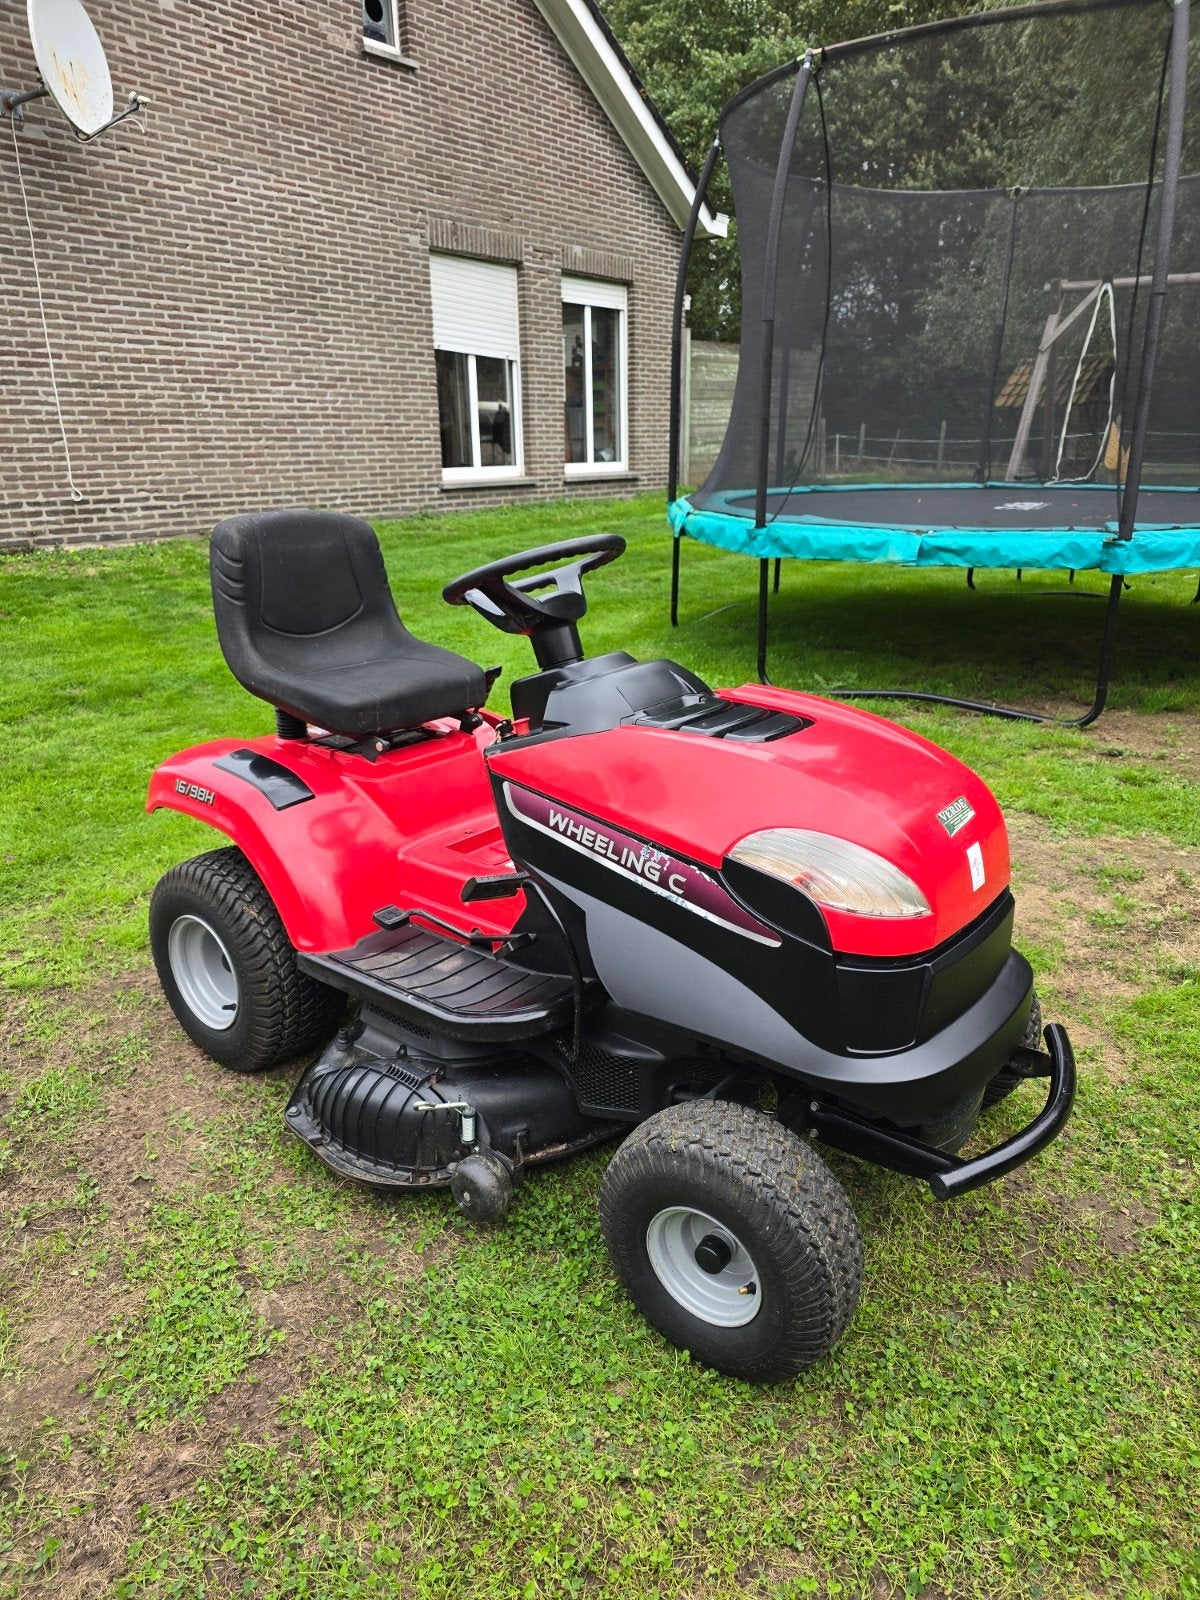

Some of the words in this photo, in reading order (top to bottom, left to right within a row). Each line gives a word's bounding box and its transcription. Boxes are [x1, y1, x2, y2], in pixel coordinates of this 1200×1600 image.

[175, 778, 215, 805] 16/98H
[548, 809, 662, 883] WHEELING
[668, 873, 687, 895] C
